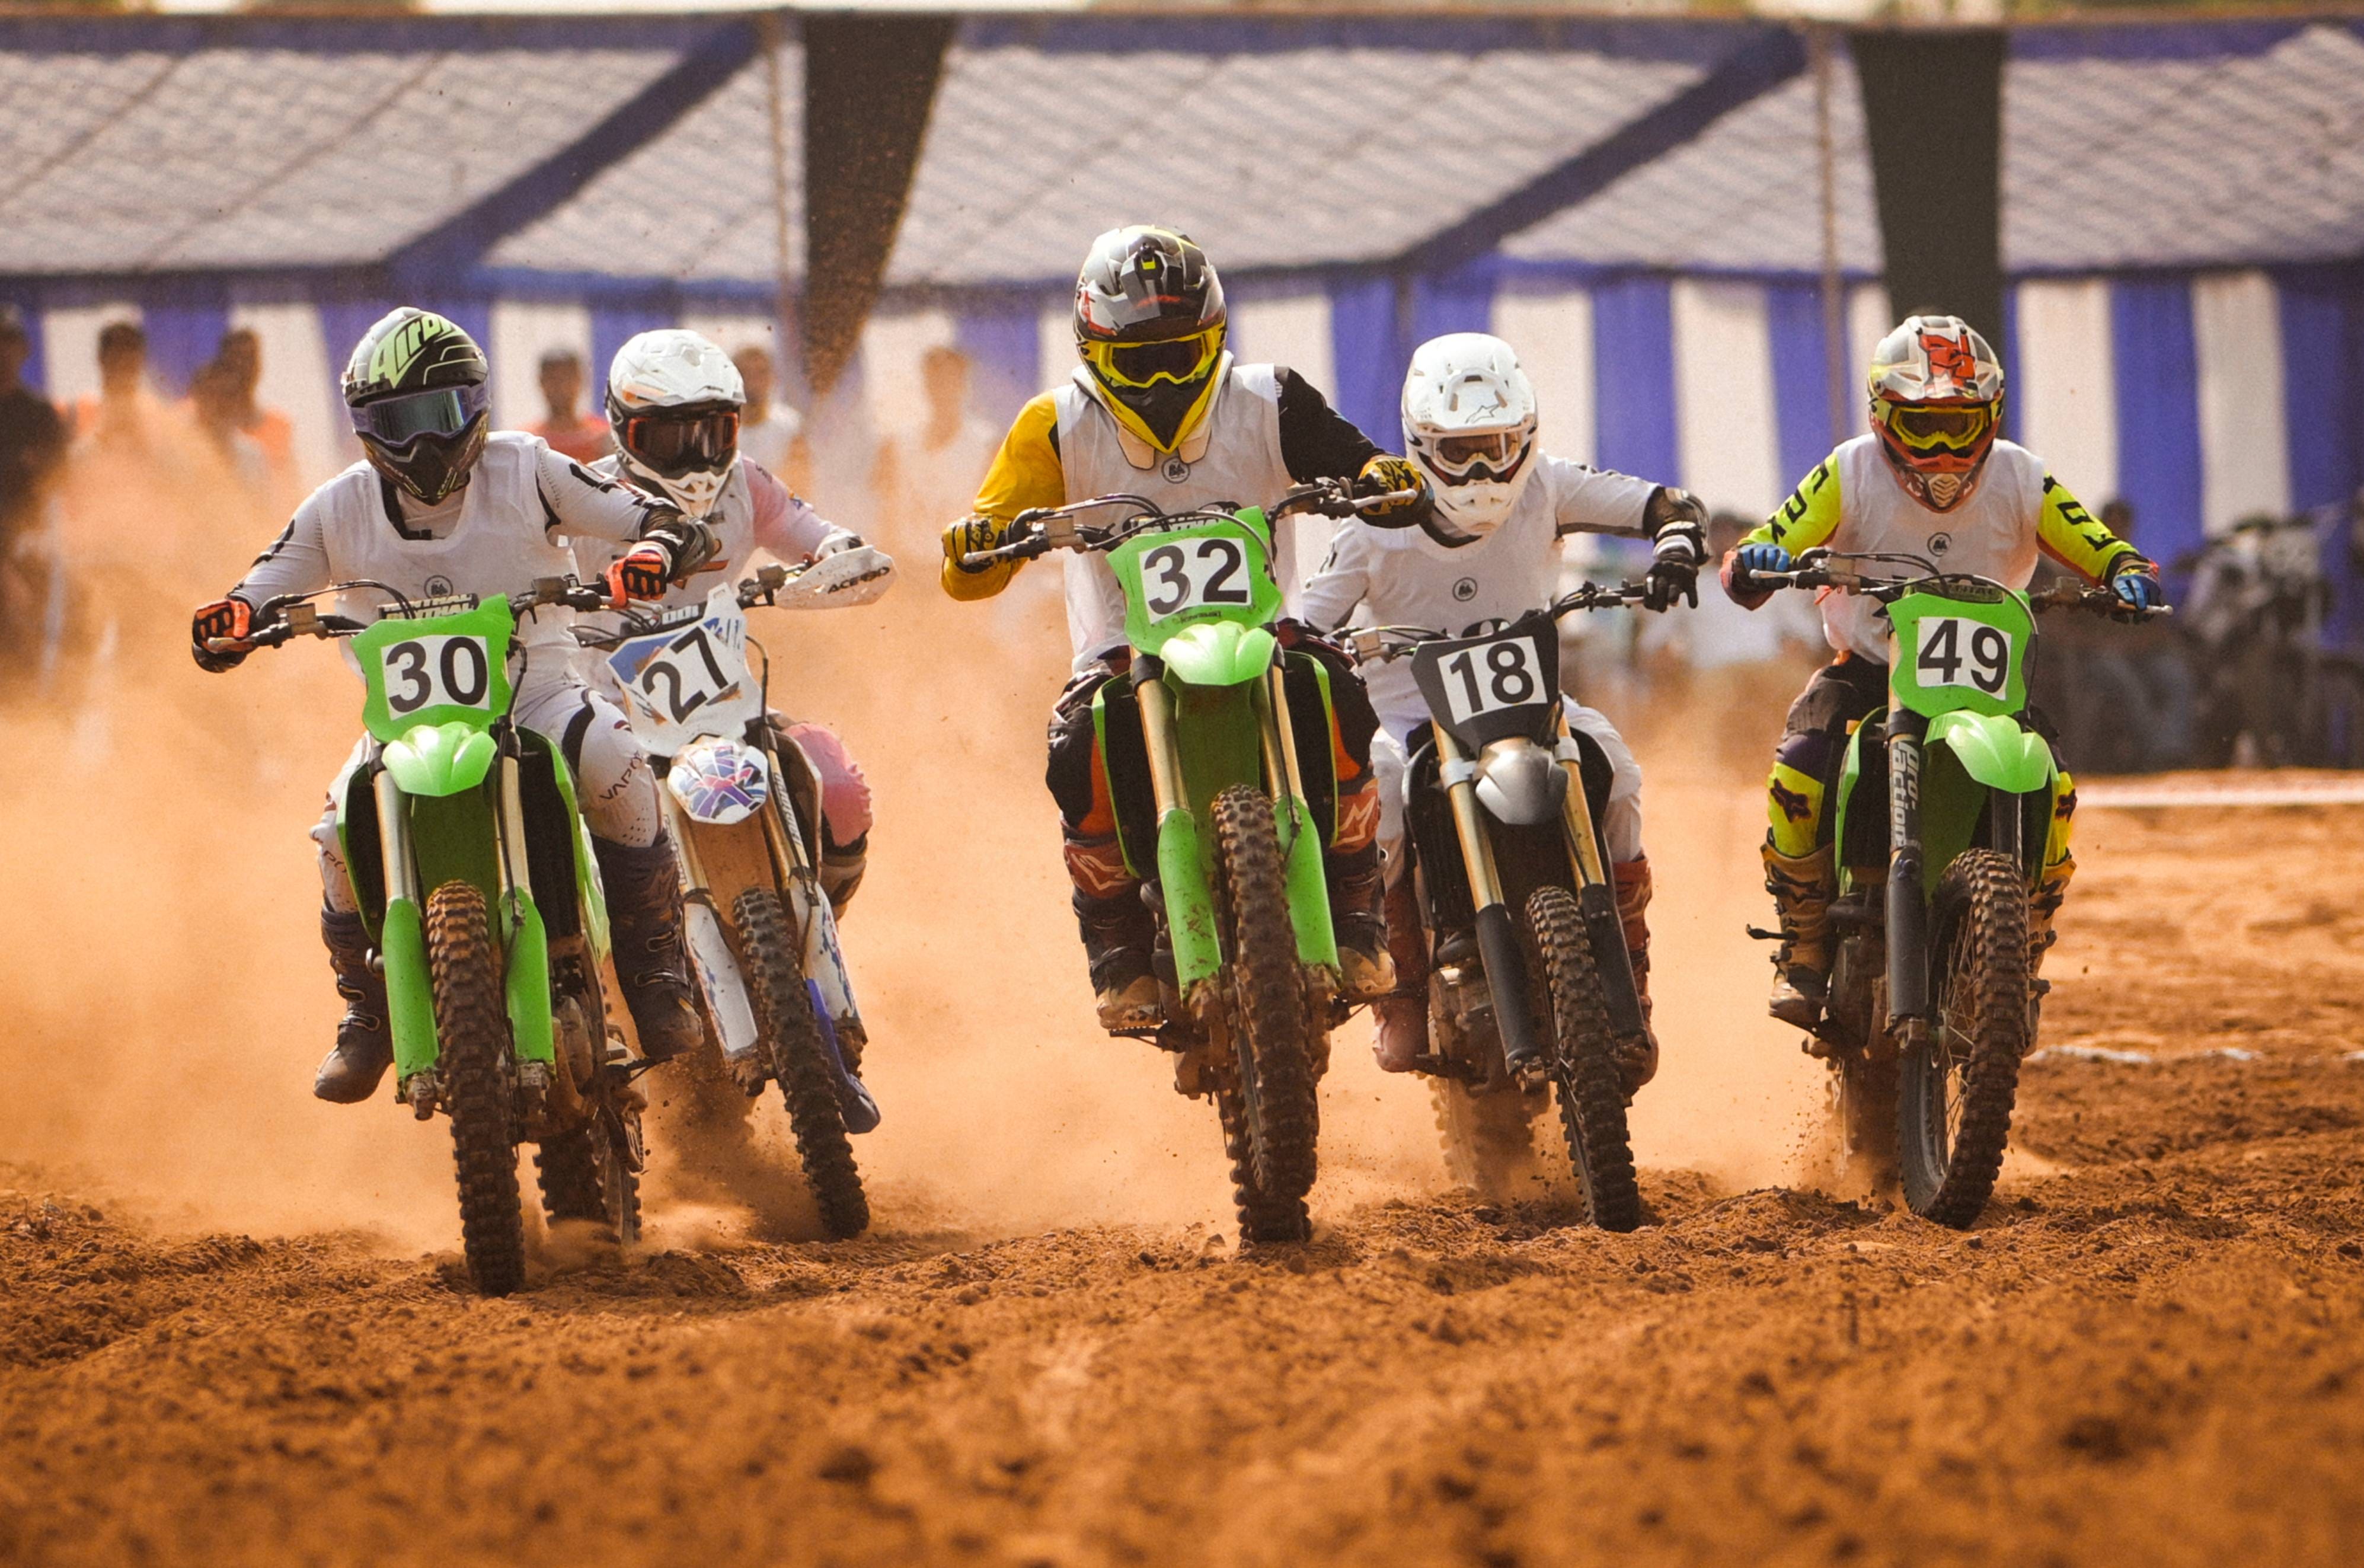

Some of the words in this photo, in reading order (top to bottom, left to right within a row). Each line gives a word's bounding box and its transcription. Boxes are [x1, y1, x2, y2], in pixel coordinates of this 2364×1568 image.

[1145, 539, 1247, 615] 32
[386, 636, 488, 713] 30
[642, 626, 729, 725] 27
[1449, 641, 1534, 714] 18
[1918, 619, 2008, 693] 49
[1892, 749, 1909, 848] action
